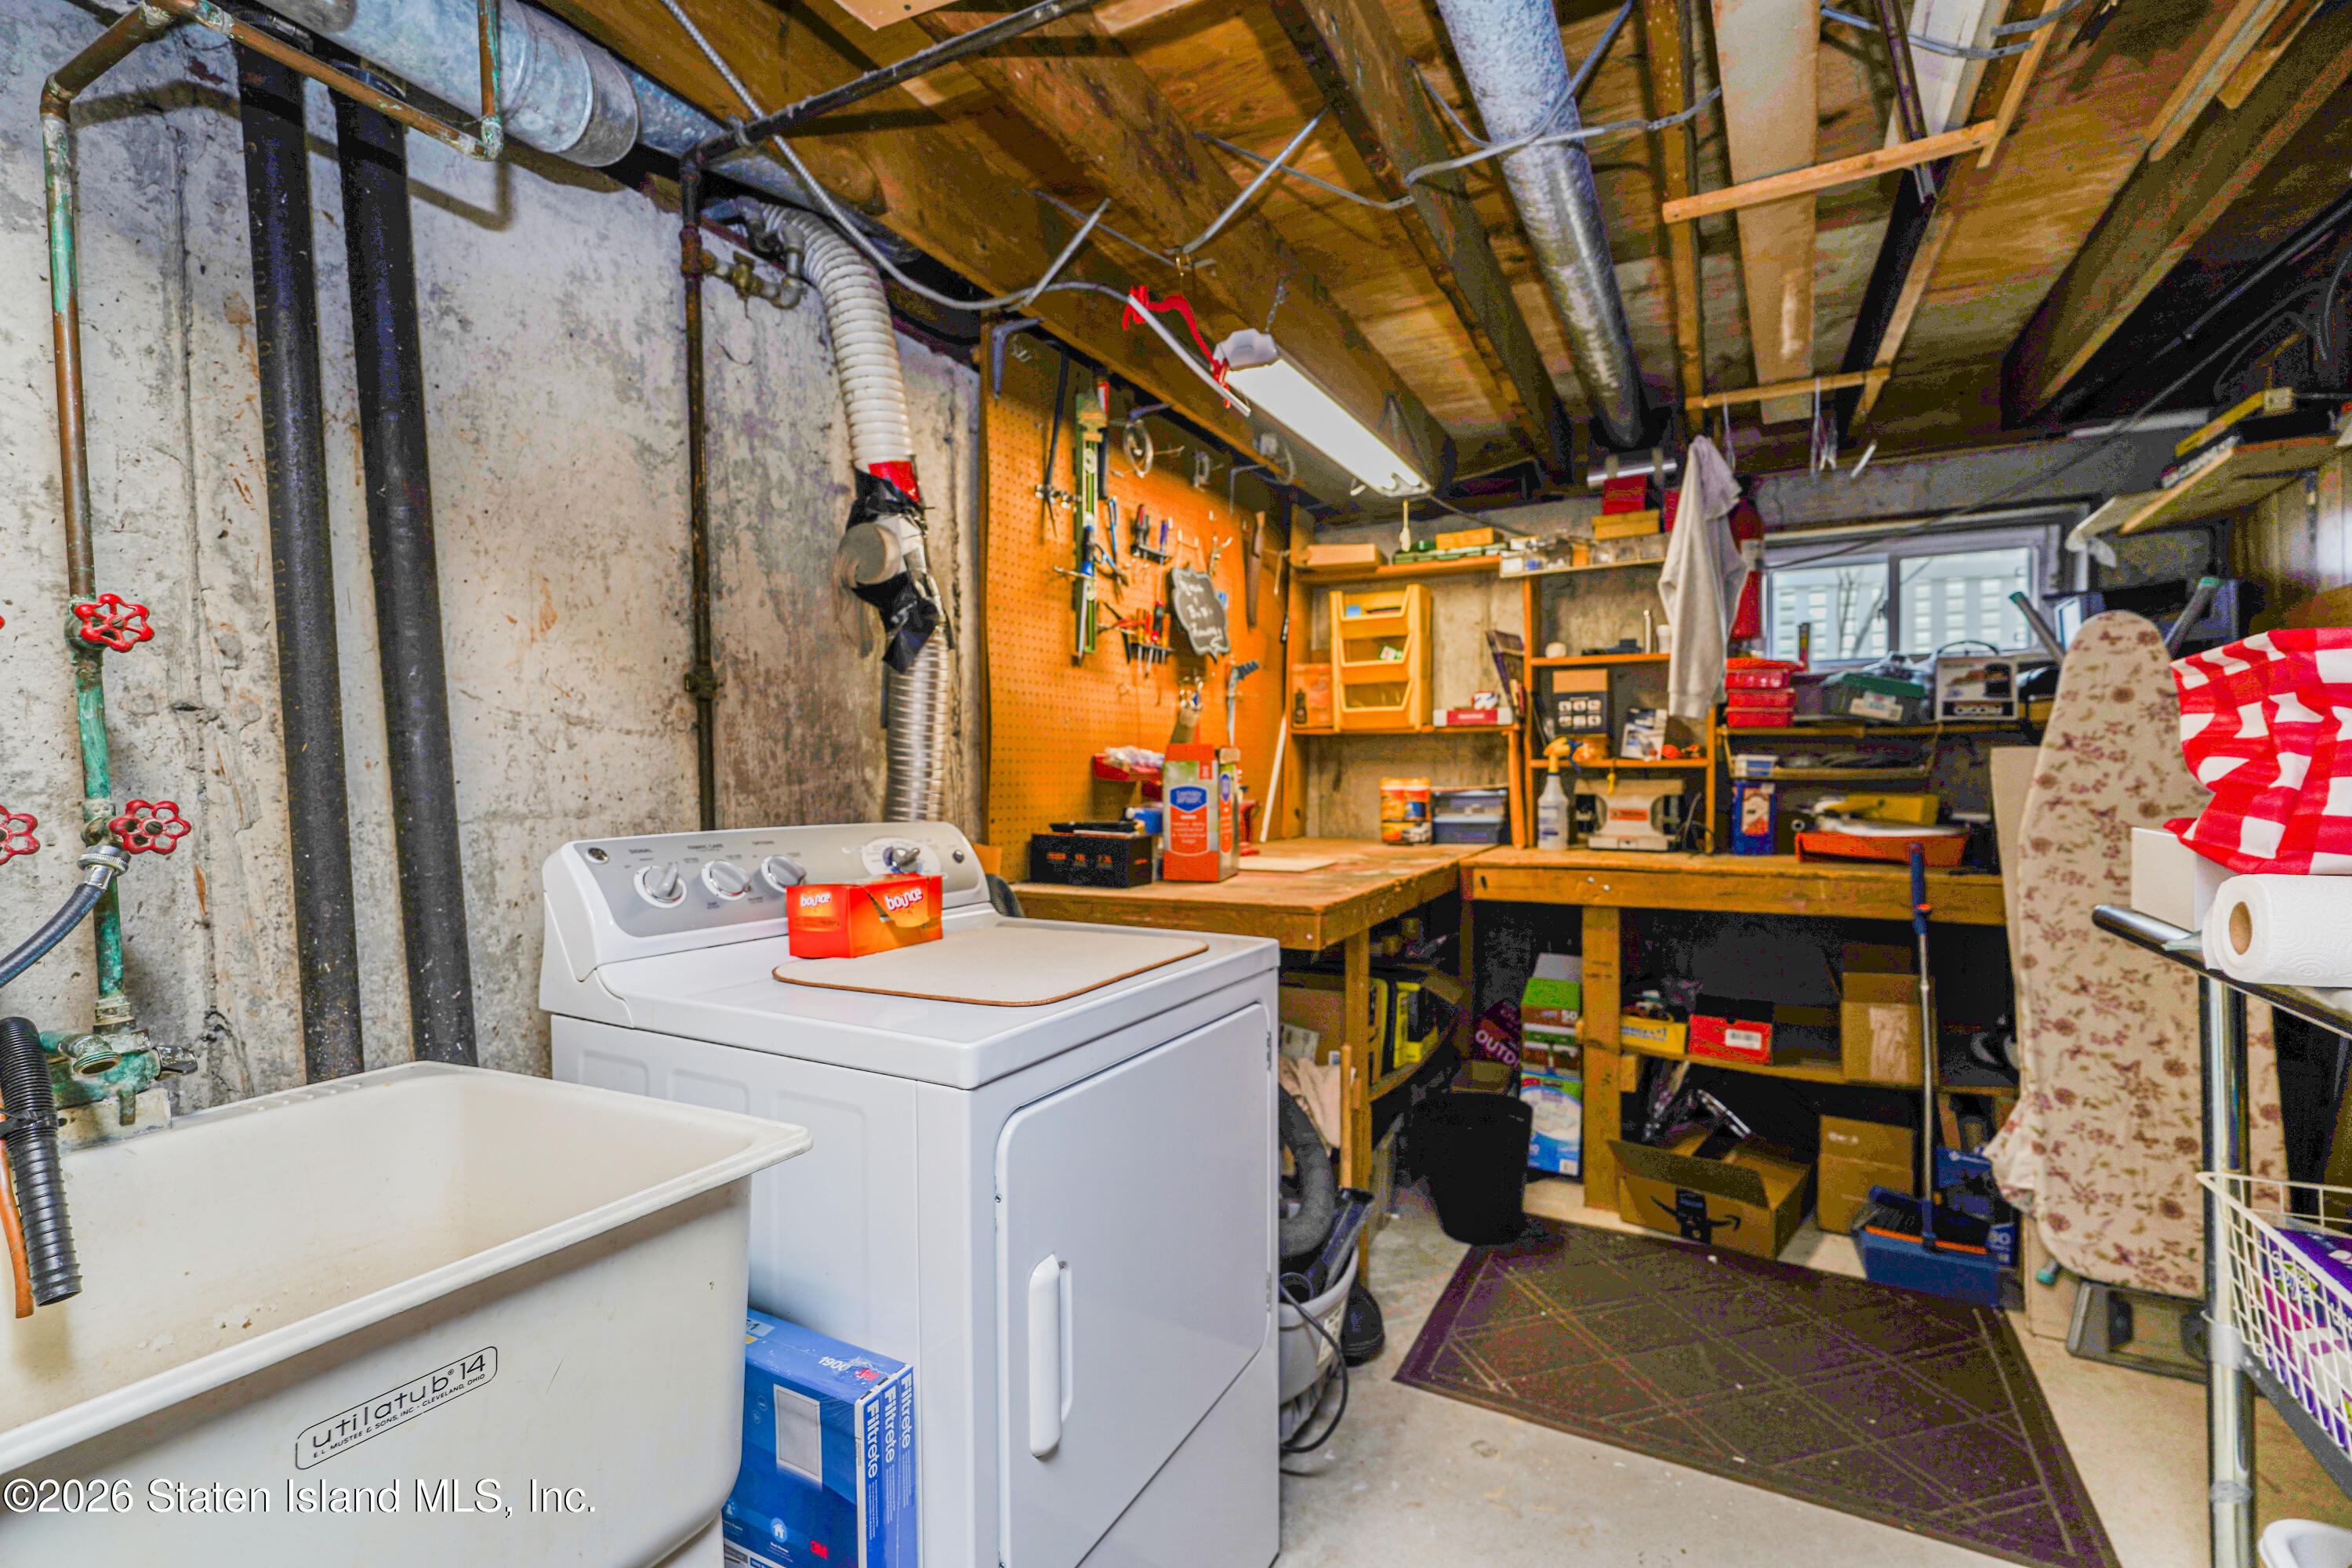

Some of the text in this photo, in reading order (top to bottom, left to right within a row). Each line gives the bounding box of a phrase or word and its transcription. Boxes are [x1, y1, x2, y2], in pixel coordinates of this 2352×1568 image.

[800, 891, 831, 908] bounce
[884, 887, 924, 912] bounce
[459, 1354, 486, 1380] 14
[467, 1374, 485, 1385] OHIO
[901, 1373, 914, 1449] Filtrete
[884, 1385, 897, 1464] Filtrete
[867, 1399, 880, 1479] Filtrete
